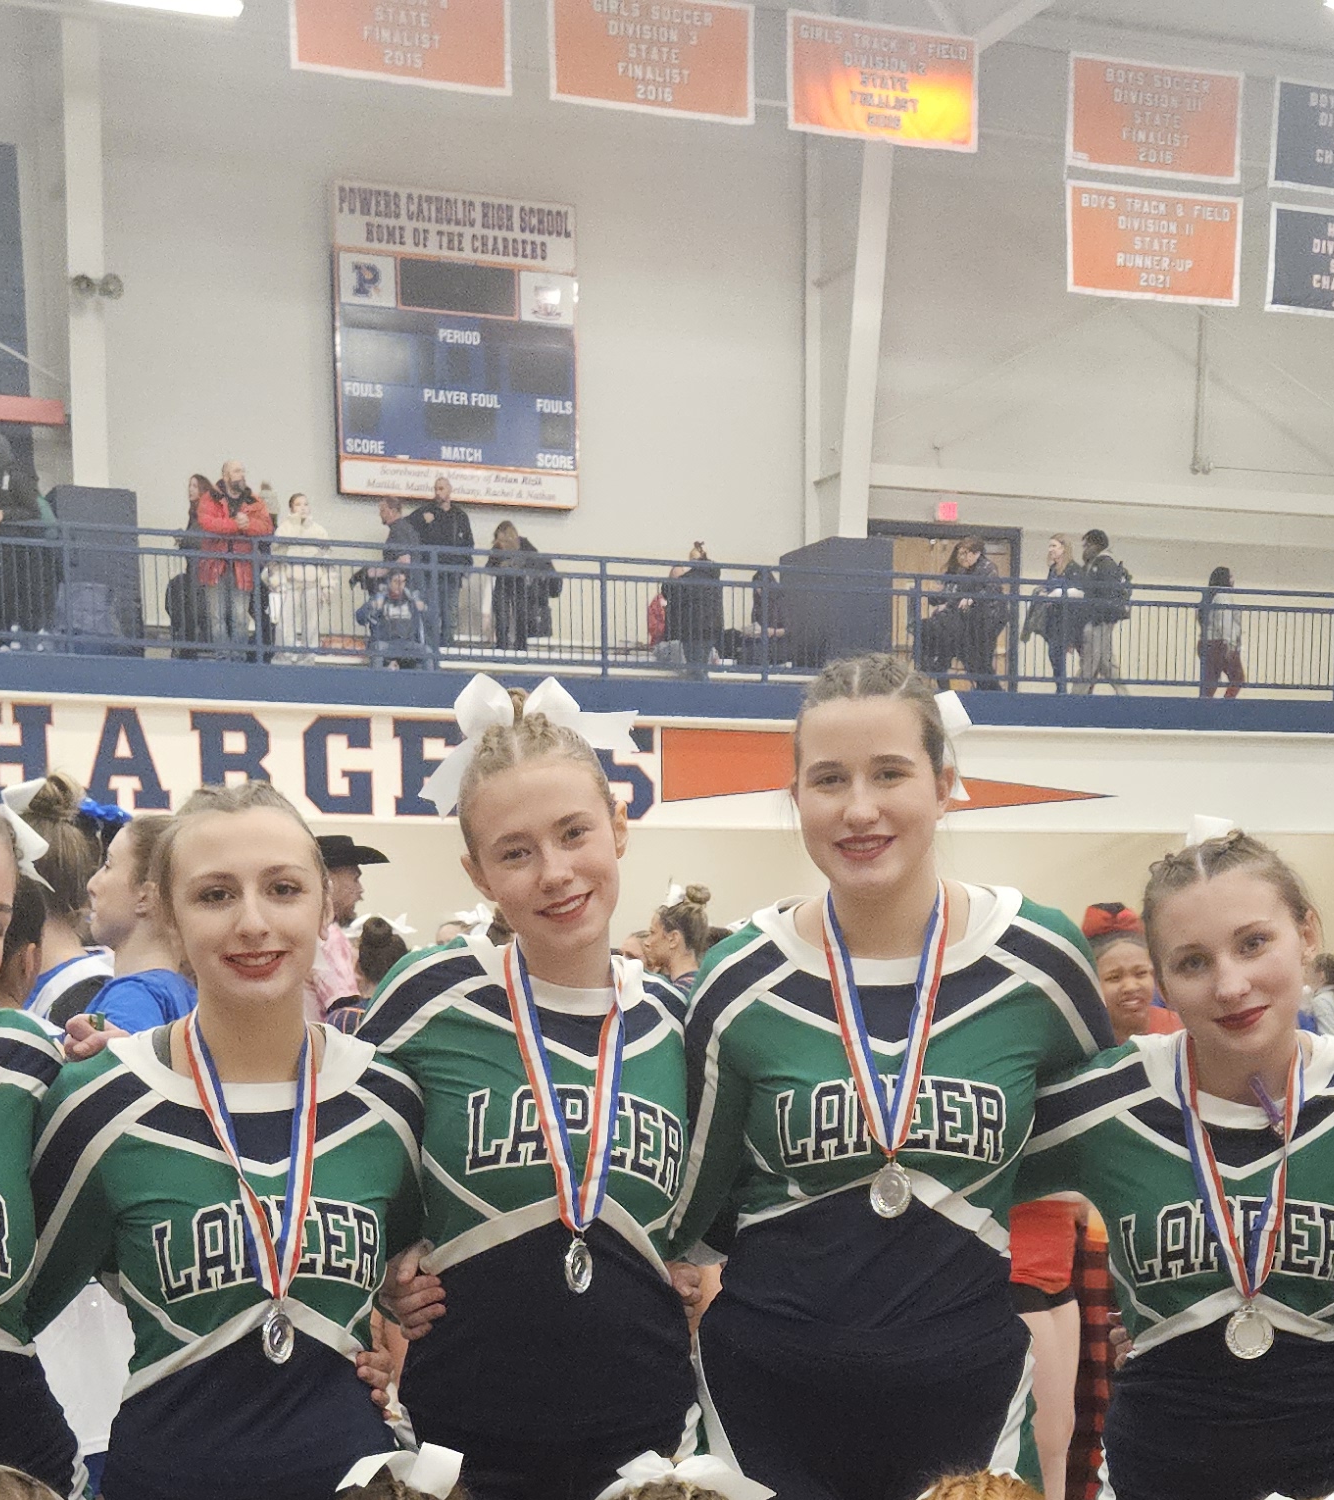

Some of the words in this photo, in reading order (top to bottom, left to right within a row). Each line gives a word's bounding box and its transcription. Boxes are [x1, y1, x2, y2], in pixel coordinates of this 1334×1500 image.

[374, 5, 431, 28] STATE
[593, 0, 641, 18] GIRLS
[651, 5, 714, 28] SOCCER
[363, 25, 441, 49] FINALIST
[607, 19, 678, 43] DIVISION
[689, 30, 698, 45] 3
[799, 24, 844, 45] GIRLS
[853, 32, 898, 53] TRACK
[927, 43, 967, 60] FIELD
[628, 43, 680, 64] STATE
[843, 52, 910, 73] DIVISION
[617, 62, 690, 85] FINALIST
[860, 71, 909, 93] STATE
[1106, 68, 1145, 85] BOYS
[1154, 74, 1210, 93] SOCCER
[850, 90, 918, 113] FINALIST
[1113, 88, 1179, 108] DIVISION
[1134, 111, 1182, 129] STATE
[1122, 128, 1189, 147] FINALIST
[338, 186, 401, 220] POWERS
[406, 193, 476, 228] CATHOLIC
[481, 201, 514, 232] HIGH
[519, 206, 571, 239] SCHOOL
[1081, 193, 1116, 209] BOYS
[1126, 198, 1167, 215] TRACK
[1193, 205, 1230, 222] FIELD
[1118, 216, 1177, 234] DIVISION
[1185, 223, 1194, 235] II
[365, 222, 406, 246] HOME
[412, 228, 429, 249] OF
[436, 230, 465, 252] THE
[471, 233, 548, 261] CHARGERS
[1133, 236, 1177, 252] STATE
[1117, 252, 1193, 272] RUNNER-UP
[1139, 272, 1170, 288] 2021
[438, 328, 481, 346] PERIOD
[344, 381, 383, 399] FOULS
[423, 388, 468, 406] PLAYER
[471, 392, 501, 409] FOUL
[536, 398, 573, 415] FOULS
[345, 438, 385, 455] SCORE
[441, 445, 483, 462] MATCH
[536, 453, 574, 470] SCORE
[151, 1194, 380, 1304] LAER
